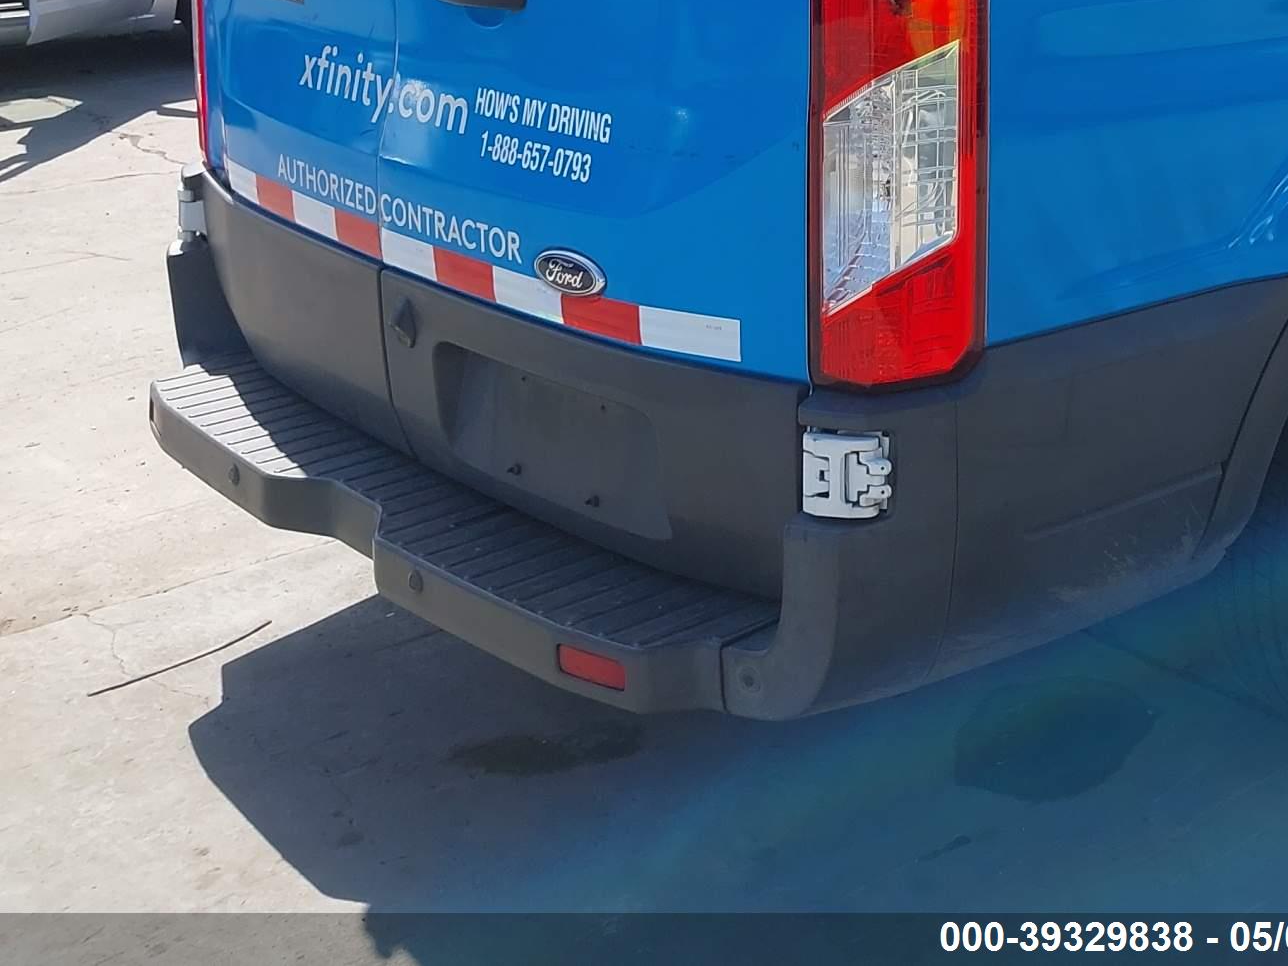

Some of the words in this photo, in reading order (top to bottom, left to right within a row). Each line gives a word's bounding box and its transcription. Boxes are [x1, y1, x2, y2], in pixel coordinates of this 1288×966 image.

[299, 45, 469, 134] xfinity.com
[474, 87, 520, 123] HOW'S
[521, 98, 547, 129] MY
[548, 103, 612, 144] DRIVING
[480, 130, 592, 183] 1-888-657-0793
[278, 153, 377, 216] AUTHORIZED
[380, 193, 523, 265] CONTRACTOR
[545, 260, 584, 289] Ford
